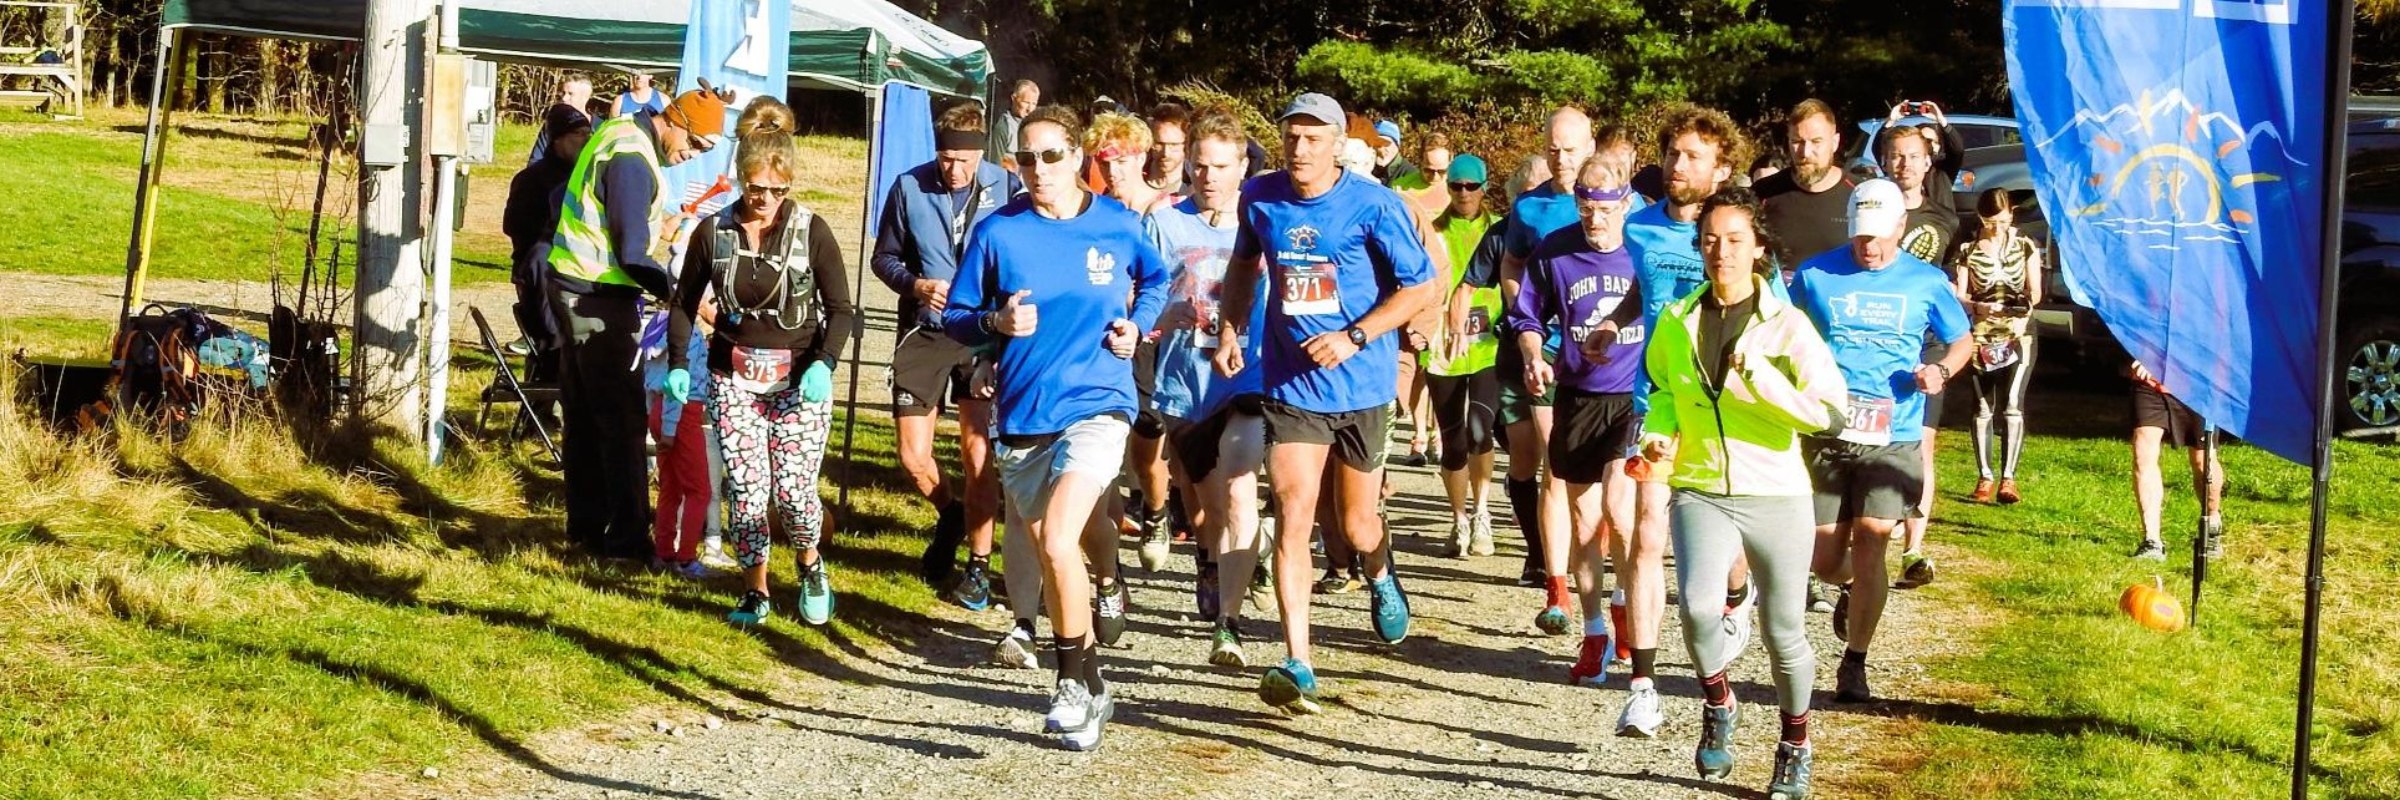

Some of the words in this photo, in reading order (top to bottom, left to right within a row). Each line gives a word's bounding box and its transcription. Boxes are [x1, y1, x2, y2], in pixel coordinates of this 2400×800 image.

[1286, 277, 1321, 301] 371
[1568, 275, 1597, 305] JOHN
[1602, 274, 1631, 295] BAP
[1570, 325, 1596, 342] TRA
[743, 359, 778, 382] 375
[1845, 405, 1878, 432] 361
